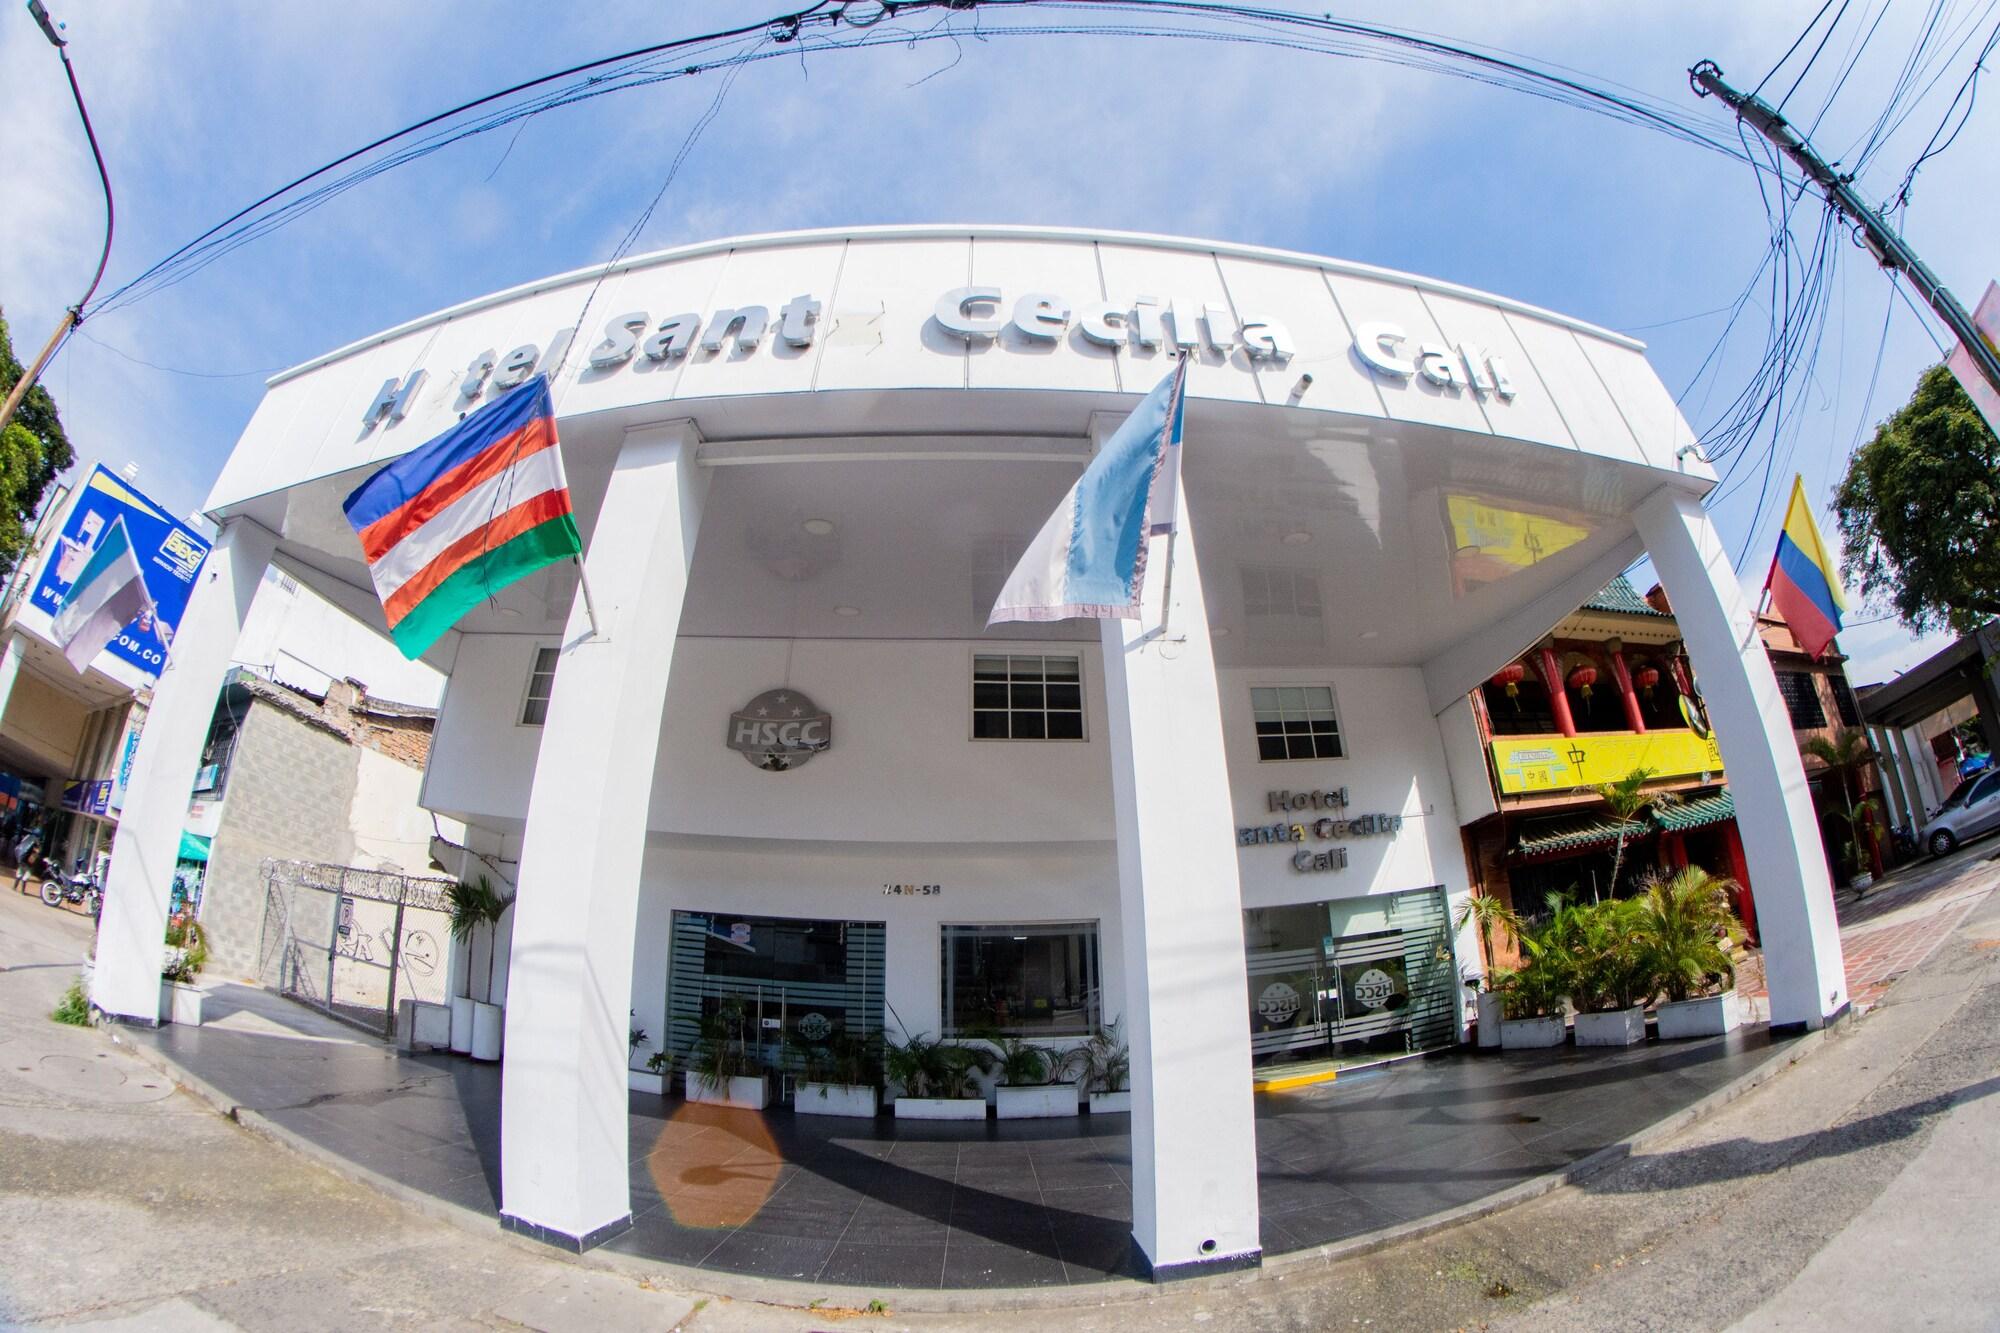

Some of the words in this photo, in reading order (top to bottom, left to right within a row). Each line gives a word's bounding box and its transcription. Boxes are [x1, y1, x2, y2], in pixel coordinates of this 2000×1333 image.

[934, 286, 1295, 363] Cecilia
[1355, 322, 1517, 403] Cali
[1567, 743, 1585, 781] 中
[1267, 787, 1349, 812] Hotel
[1238, 823, 1305, 847] anta
[1314, 813, 1402, 840] Cecilia
[1294, 847, 1348, 872] Cali
